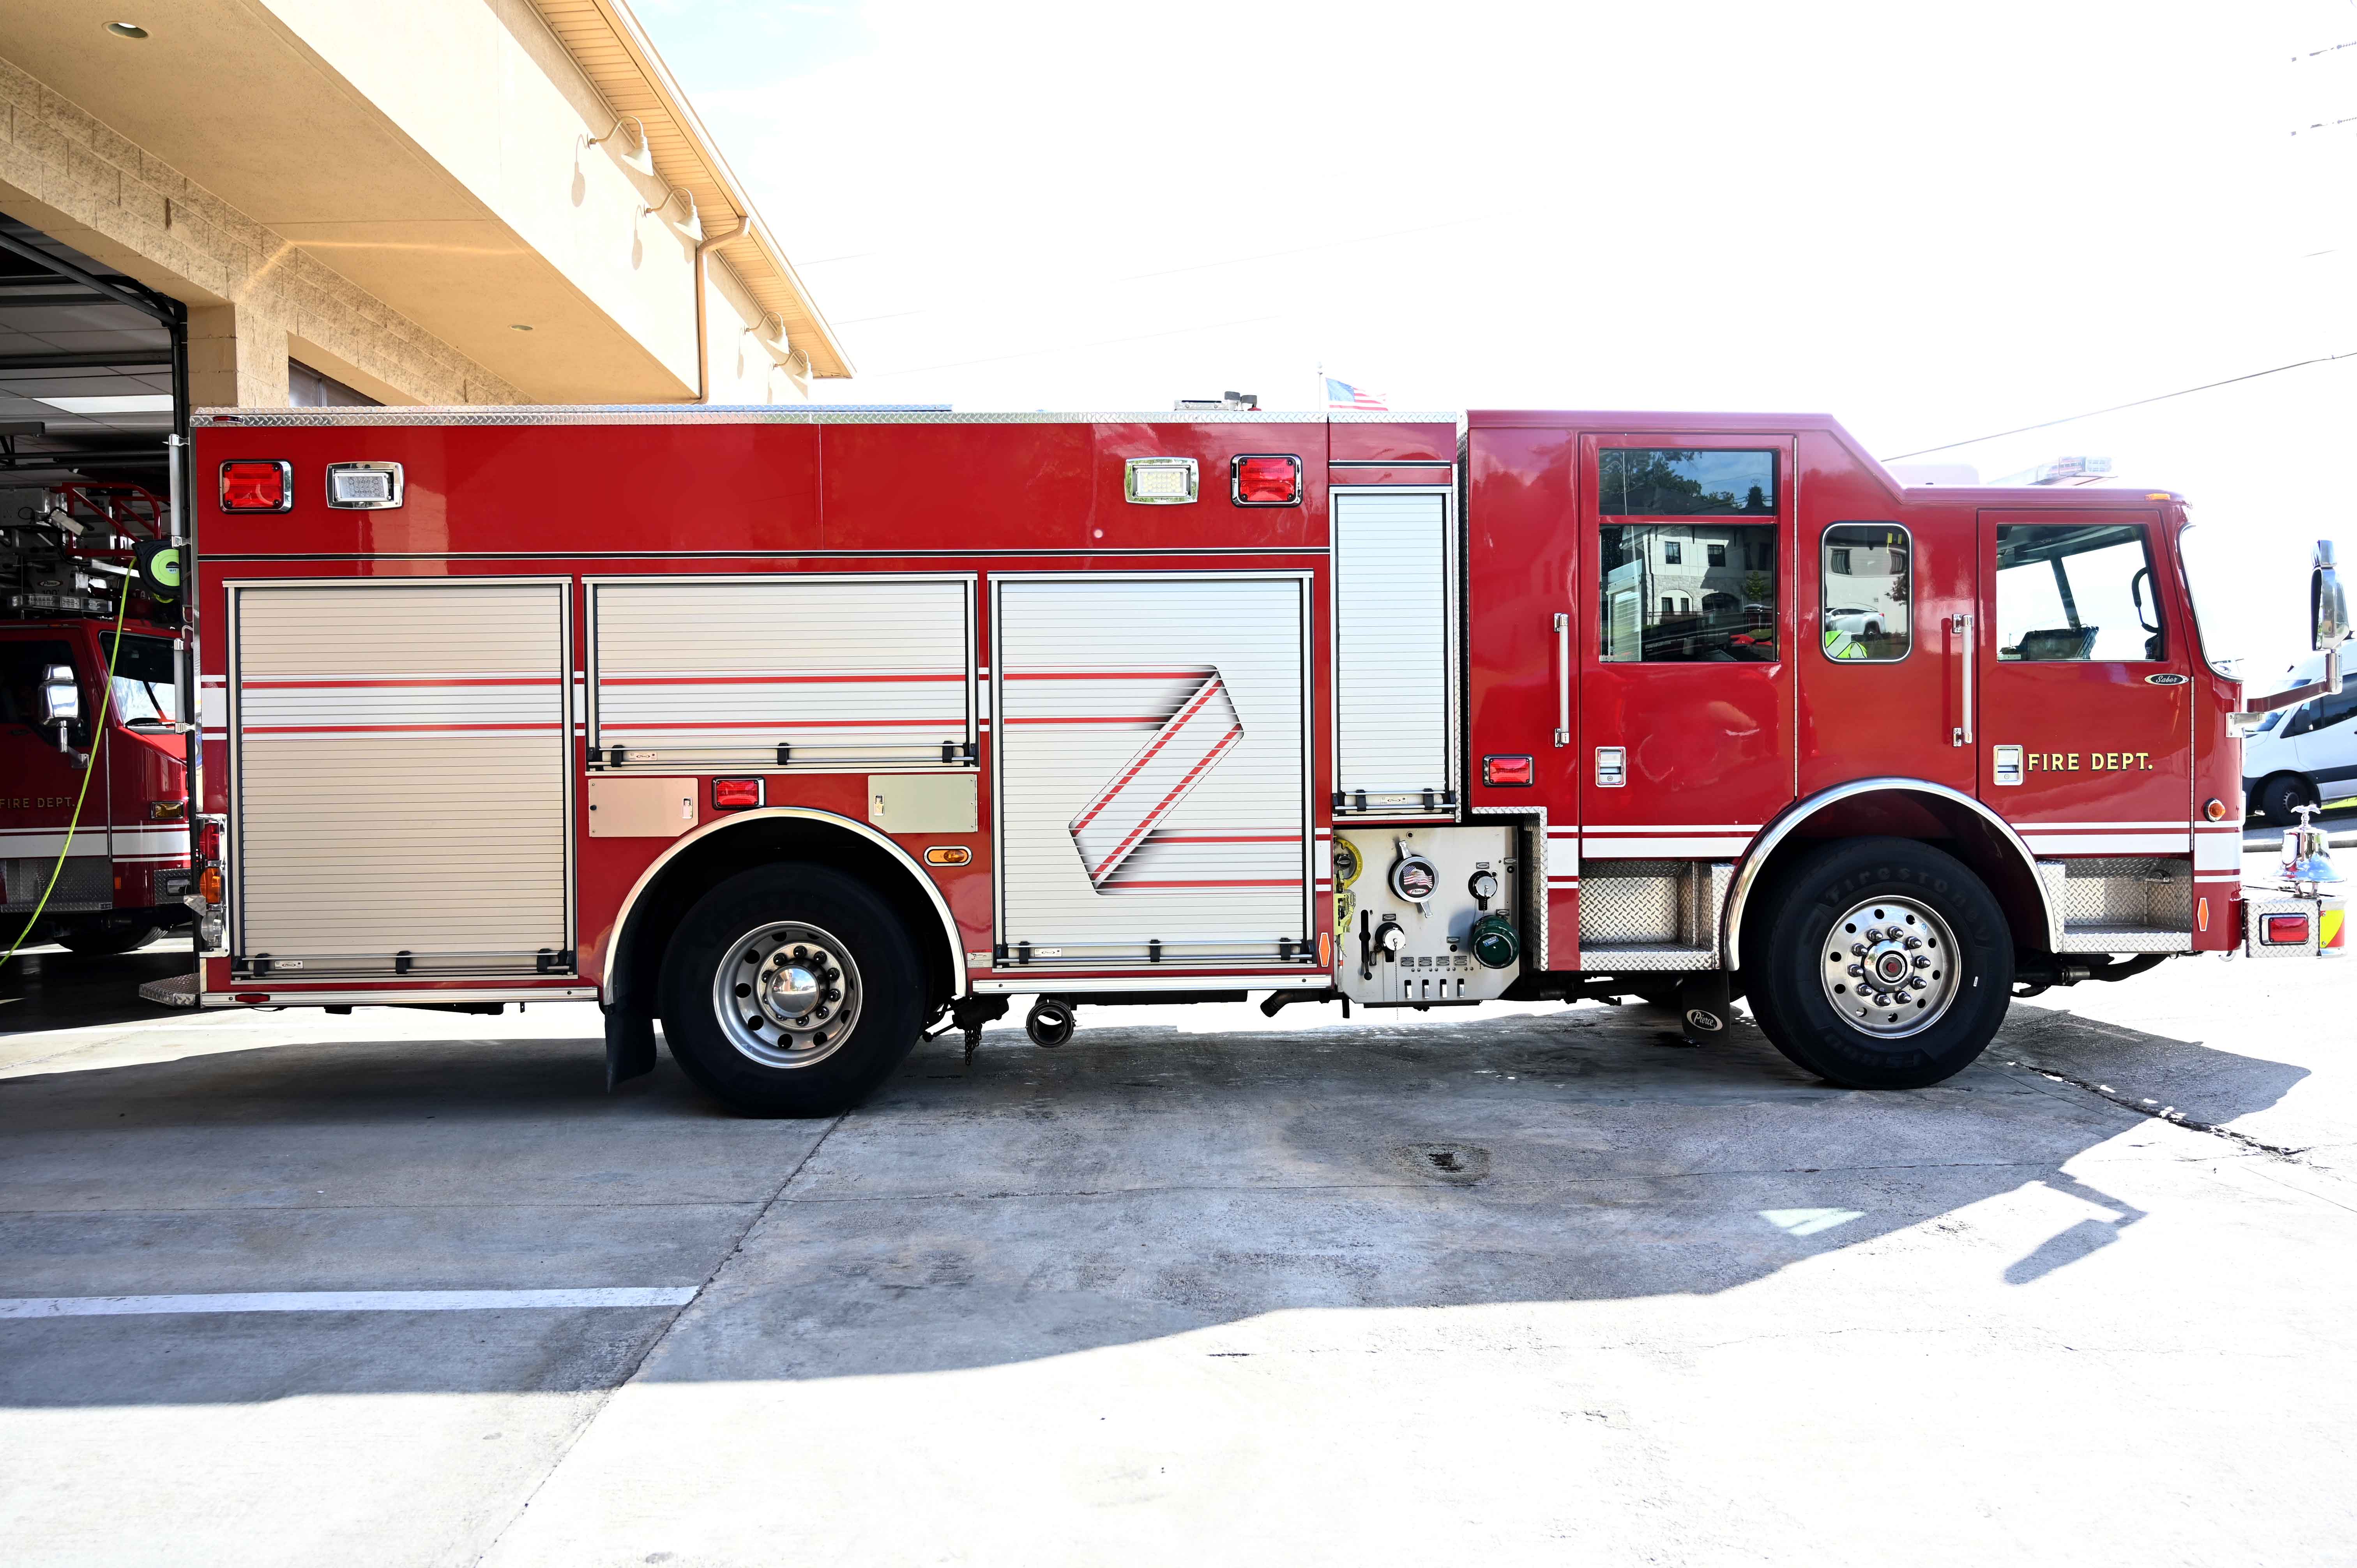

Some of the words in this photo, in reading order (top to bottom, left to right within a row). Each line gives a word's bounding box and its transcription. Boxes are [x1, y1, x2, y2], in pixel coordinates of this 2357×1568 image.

[2028, 753, 2079, 771] FIRE
[2091, 752, 2153, 770] DEPT.
[0, 798, 30, 808] FIRE
[37, 797, 75, 808] DEPT.
[1694, 1011, 1714, 1026] Pierce
